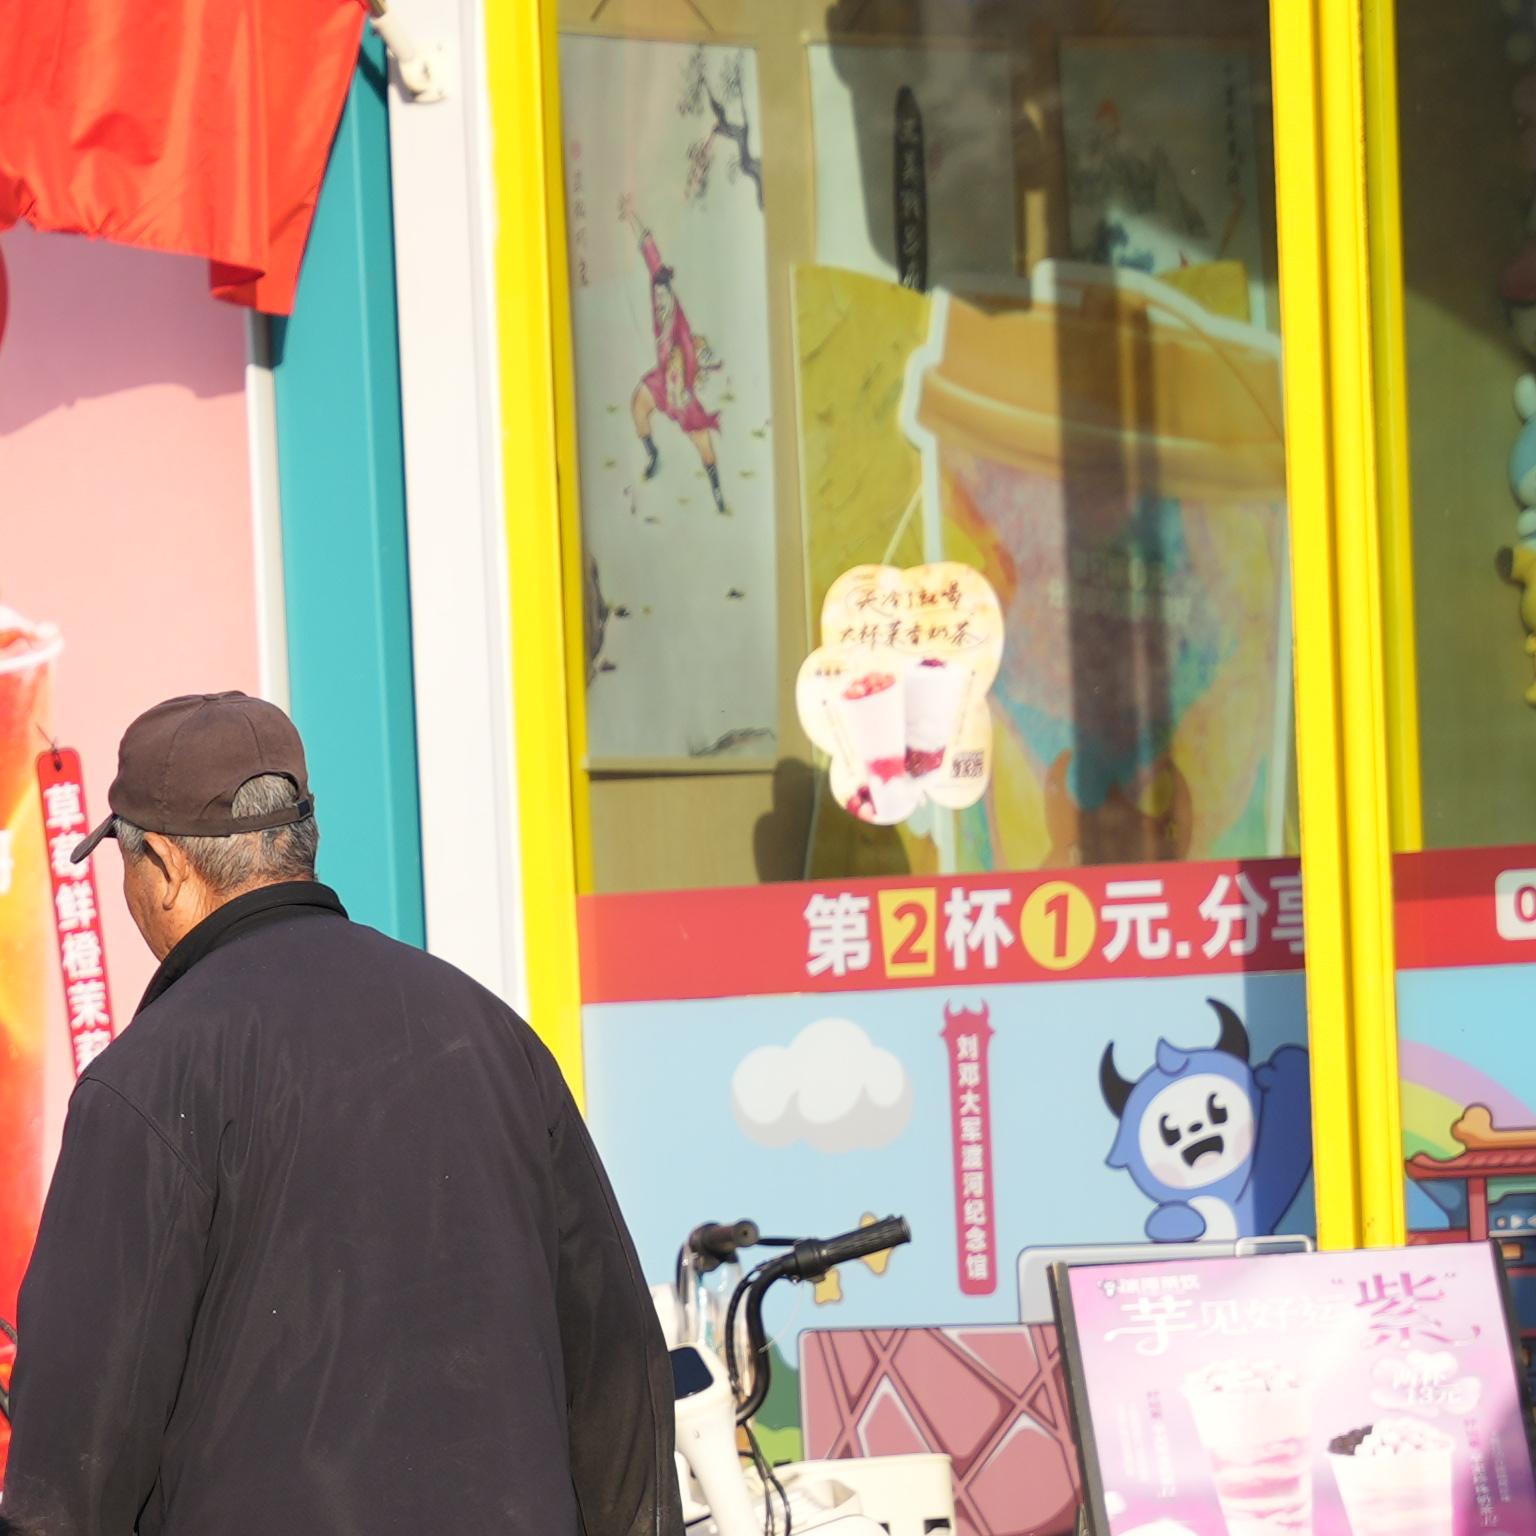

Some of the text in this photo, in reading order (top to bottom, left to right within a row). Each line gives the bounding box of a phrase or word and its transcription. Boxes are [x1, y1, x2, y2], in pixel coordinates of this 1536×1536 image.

[956, 1033, 989, 1281] 刘邓大军渡河纪念馆
